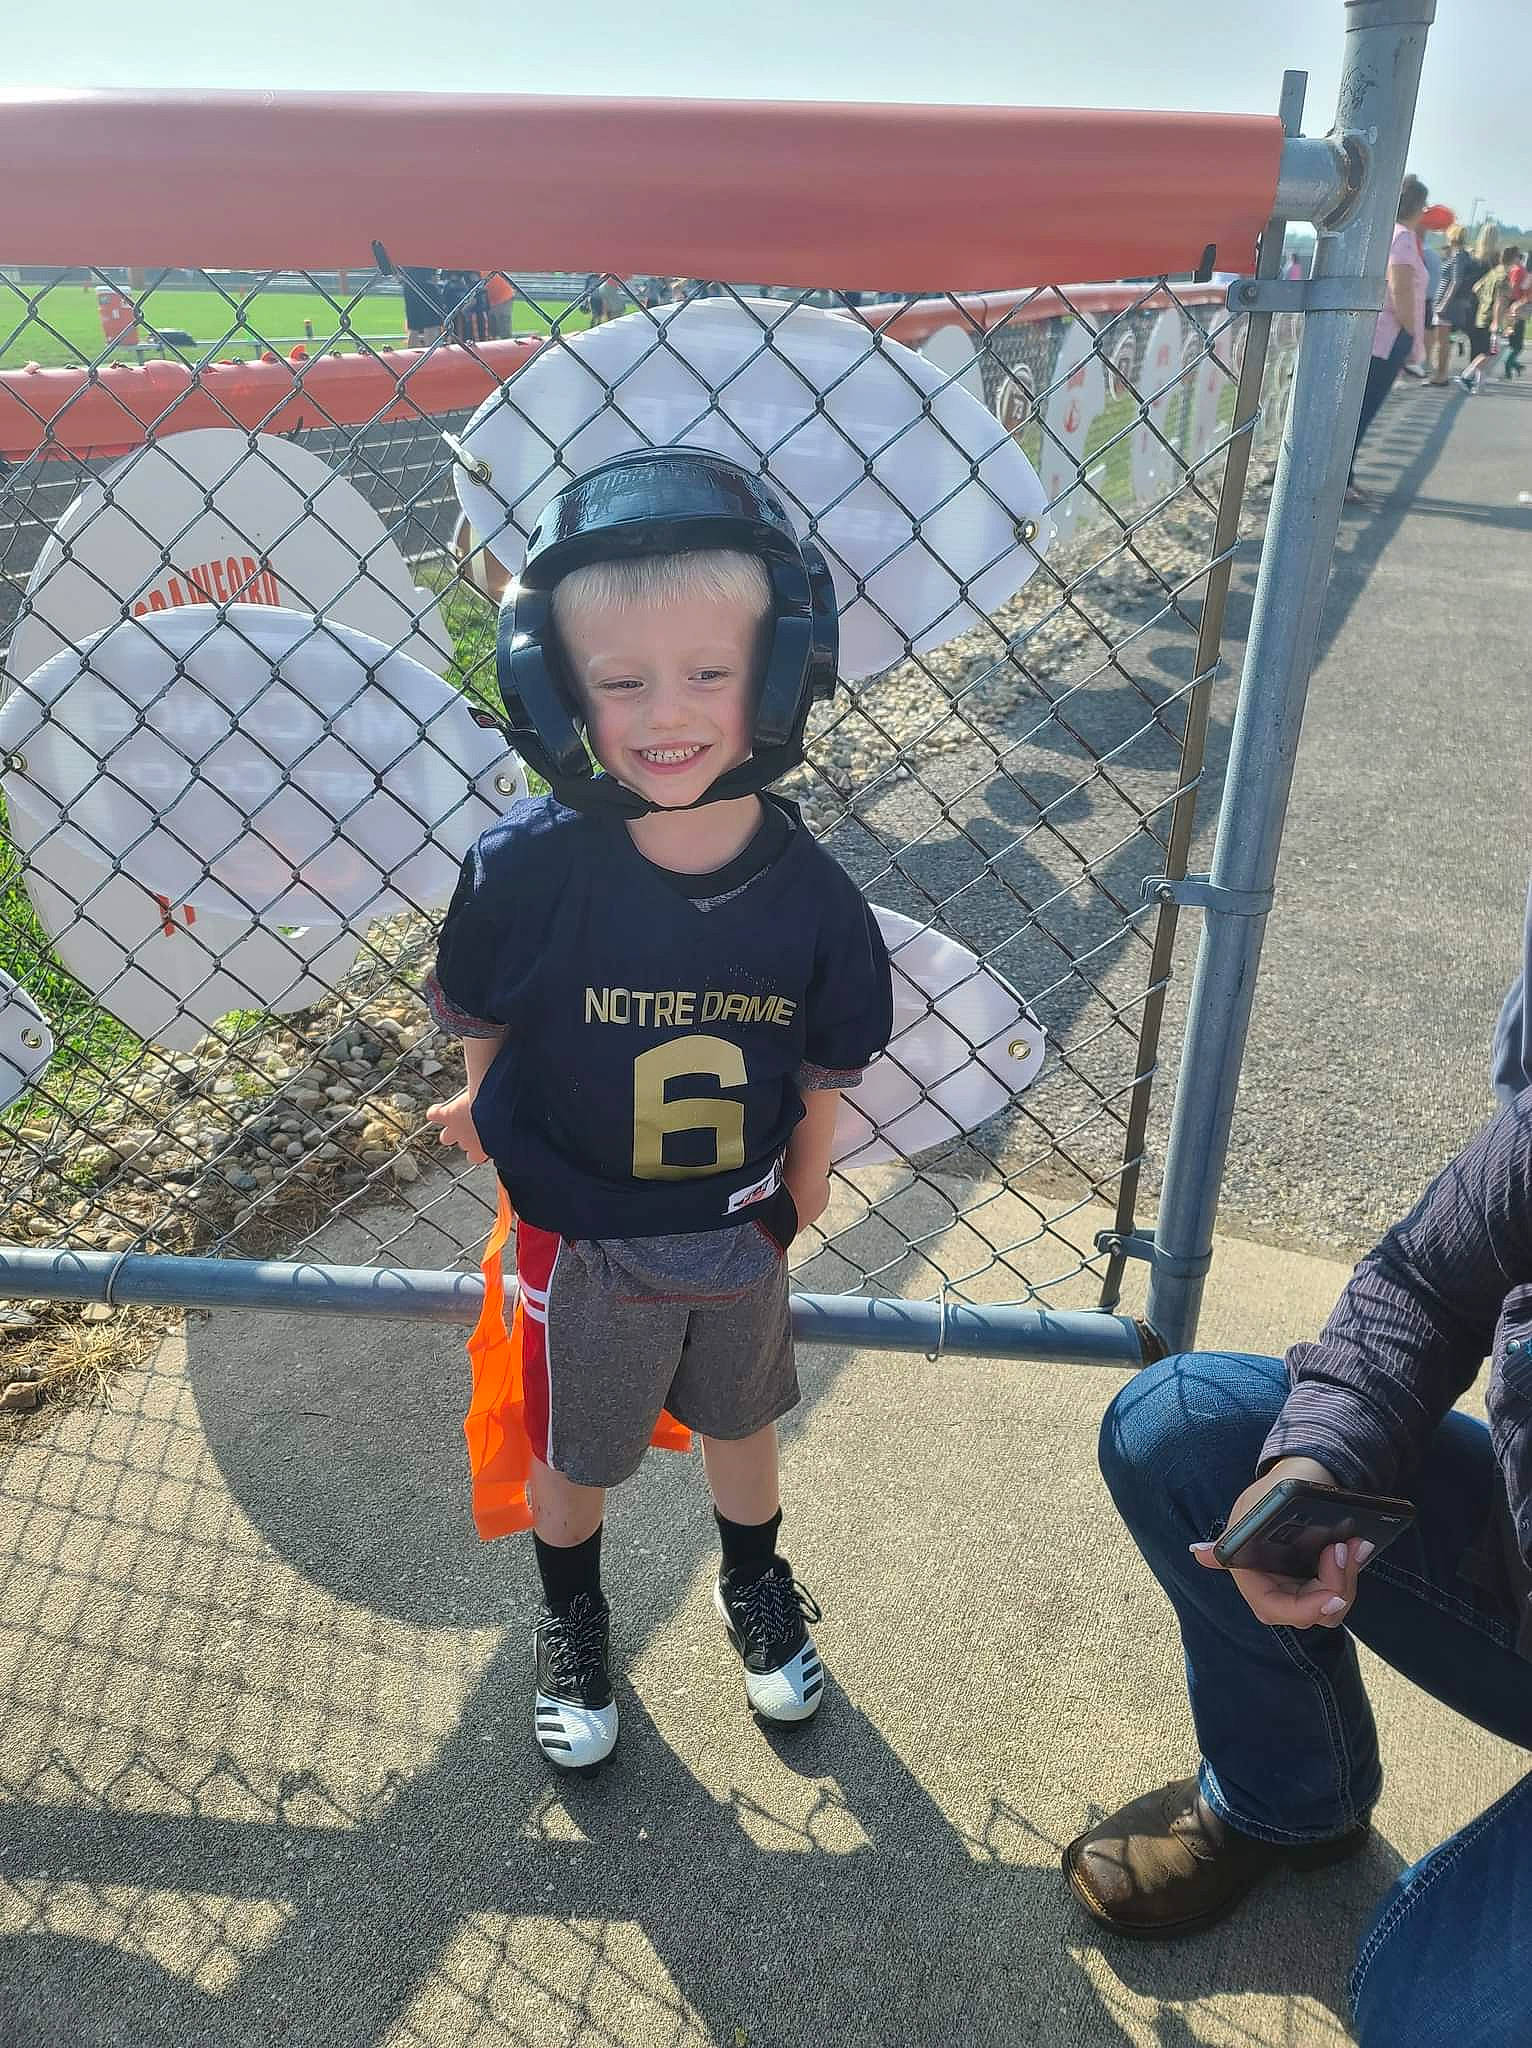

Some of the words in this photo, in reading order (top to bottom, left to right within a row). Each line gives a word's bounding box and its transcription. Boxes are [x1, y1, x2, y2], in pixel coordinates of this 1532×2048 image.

[585, 987, 697, 1027] NOTRE
[701, 991, 797, 1026] DAME
[633, 1034, 748, 1181] 6
